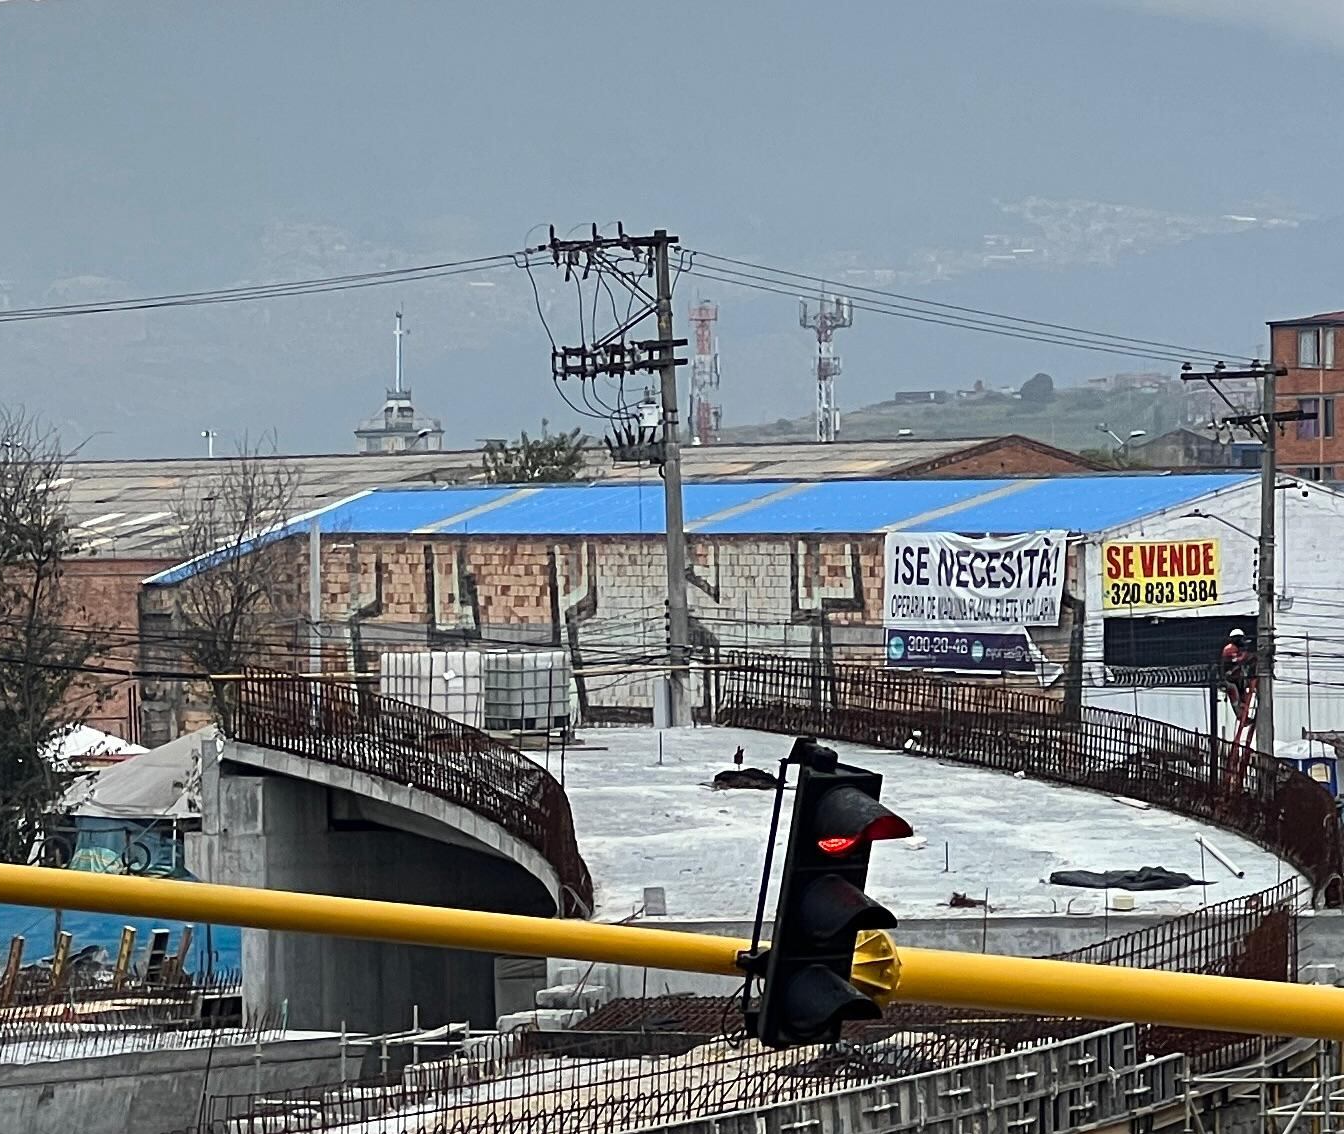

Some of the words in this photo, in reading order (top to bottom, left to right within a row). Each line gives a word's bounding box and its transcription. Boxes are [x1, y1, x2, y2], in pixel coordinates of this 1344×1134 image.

[894, 546, 930, 586] ¡SE
[1106, 545, 1135, 580] SE
[1140, 543, 1215, 578] VENDE
[1111, 582, 1141, 605] 320
[1145, 581, 1175, 604] 833
[1178, 579, 1217, 602] 9384
